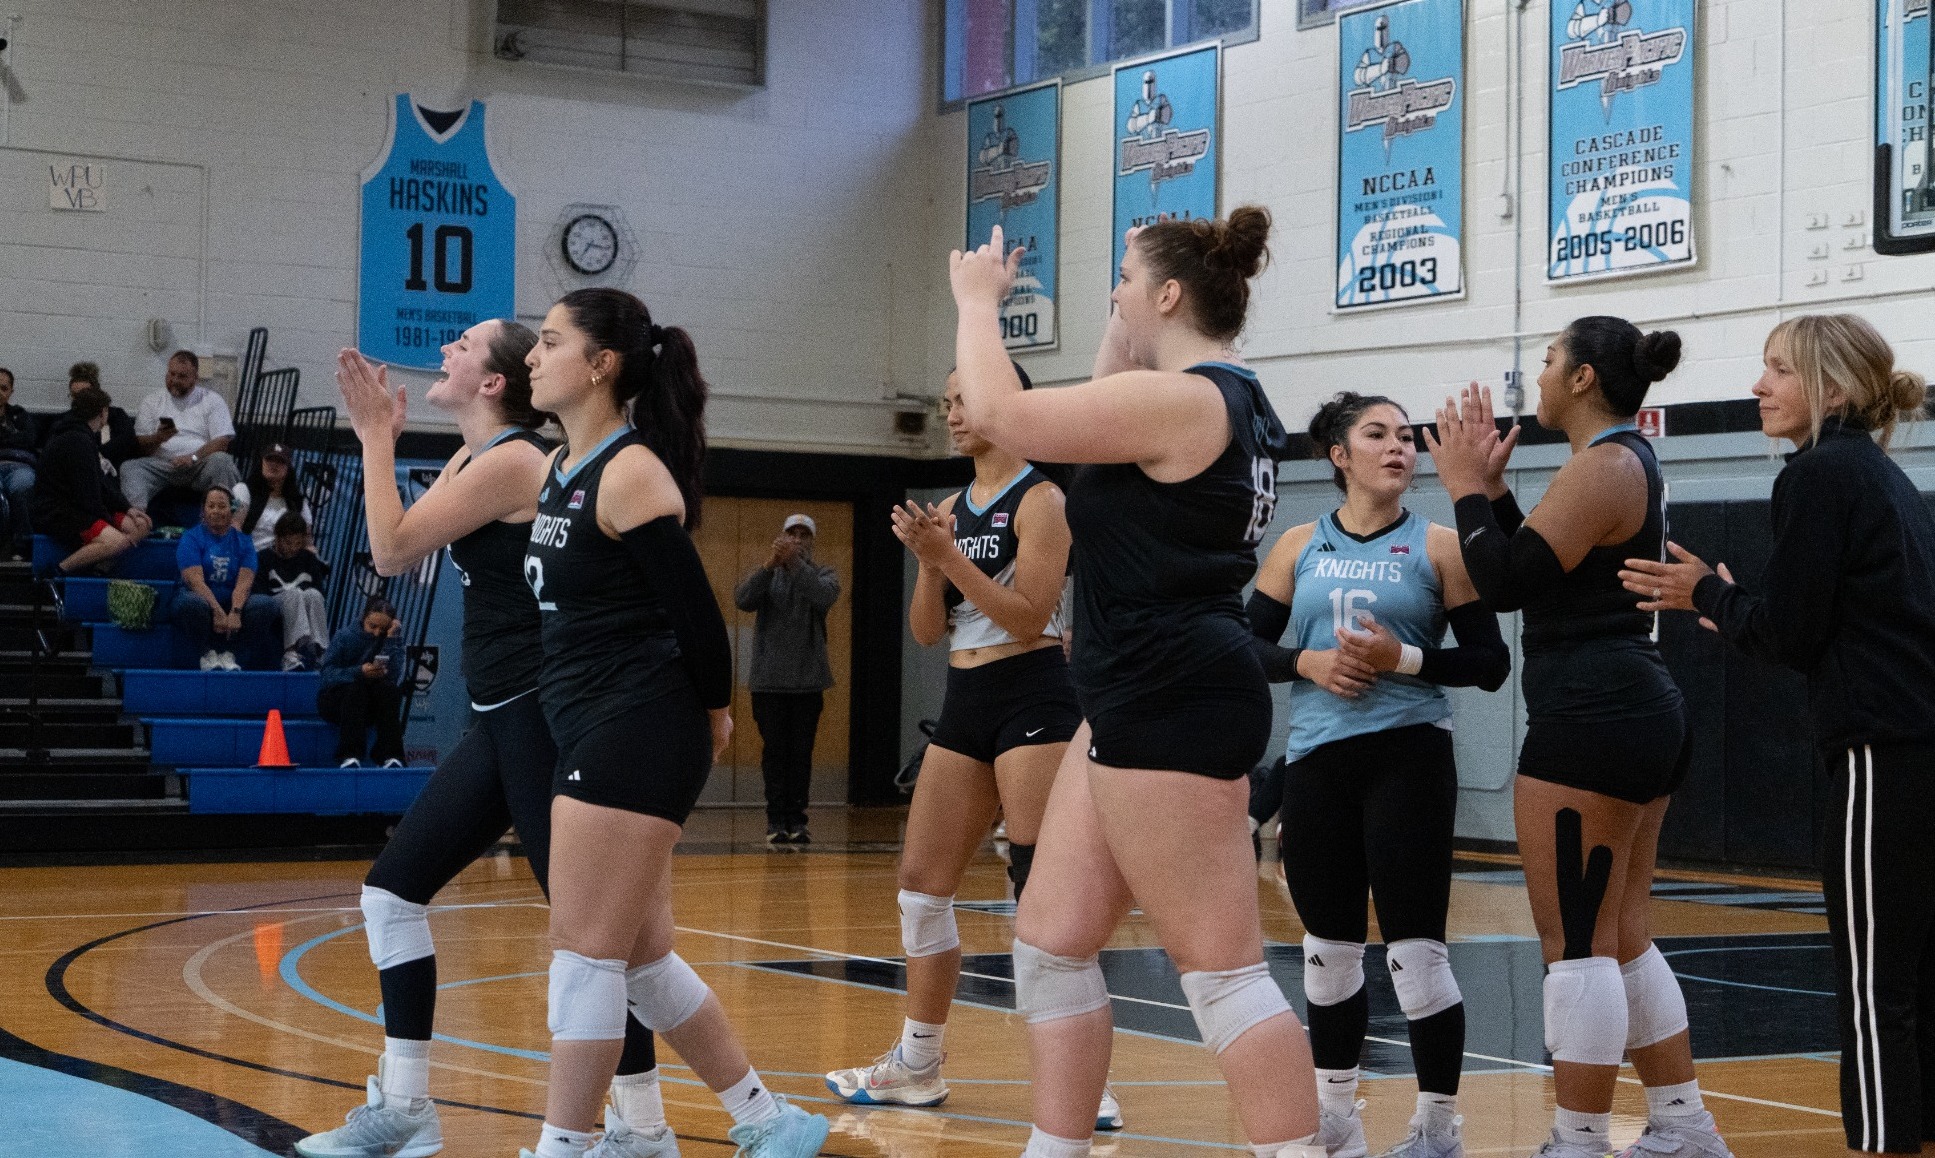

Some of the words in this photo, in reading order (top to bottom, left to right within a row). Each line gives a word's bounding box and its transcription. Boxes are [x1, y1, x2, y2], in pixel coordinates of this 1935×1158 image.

[1575, 125, 1663, 156] CASCADE
[410, 159, 468, 179] MARSHALL
[1561, 143, 1680, 178] CONFERENCE
[50, 164, 103, 190] WPU
[1362, 166, 1435, 196] NCCAA
[1565, 164, 1674, 196] CHAMPIONS
[64, 187, 98, 208] VB
[390, 176, 488, 217] HASKINS
[1363, 205, 1436, 225] BASKETBALL
[1578, 201, 1661, 224] BASKETBALL
[1361, 235, 1436, 256] CHAMPIONS
[1369, 224, 1429, 243] REGIONAL
[1556, 218, 1685, 262] 2005-2006
[405, 221, 474, 294] 10
[1359, 257, 1437, 293] 2003
[998, 313, 1037, 339] 000
[1243, 455, 1277, 541] 18
[1314, 558, 1402, 583] KNIGHTS
[1328, 587, 1378, 638] 16
